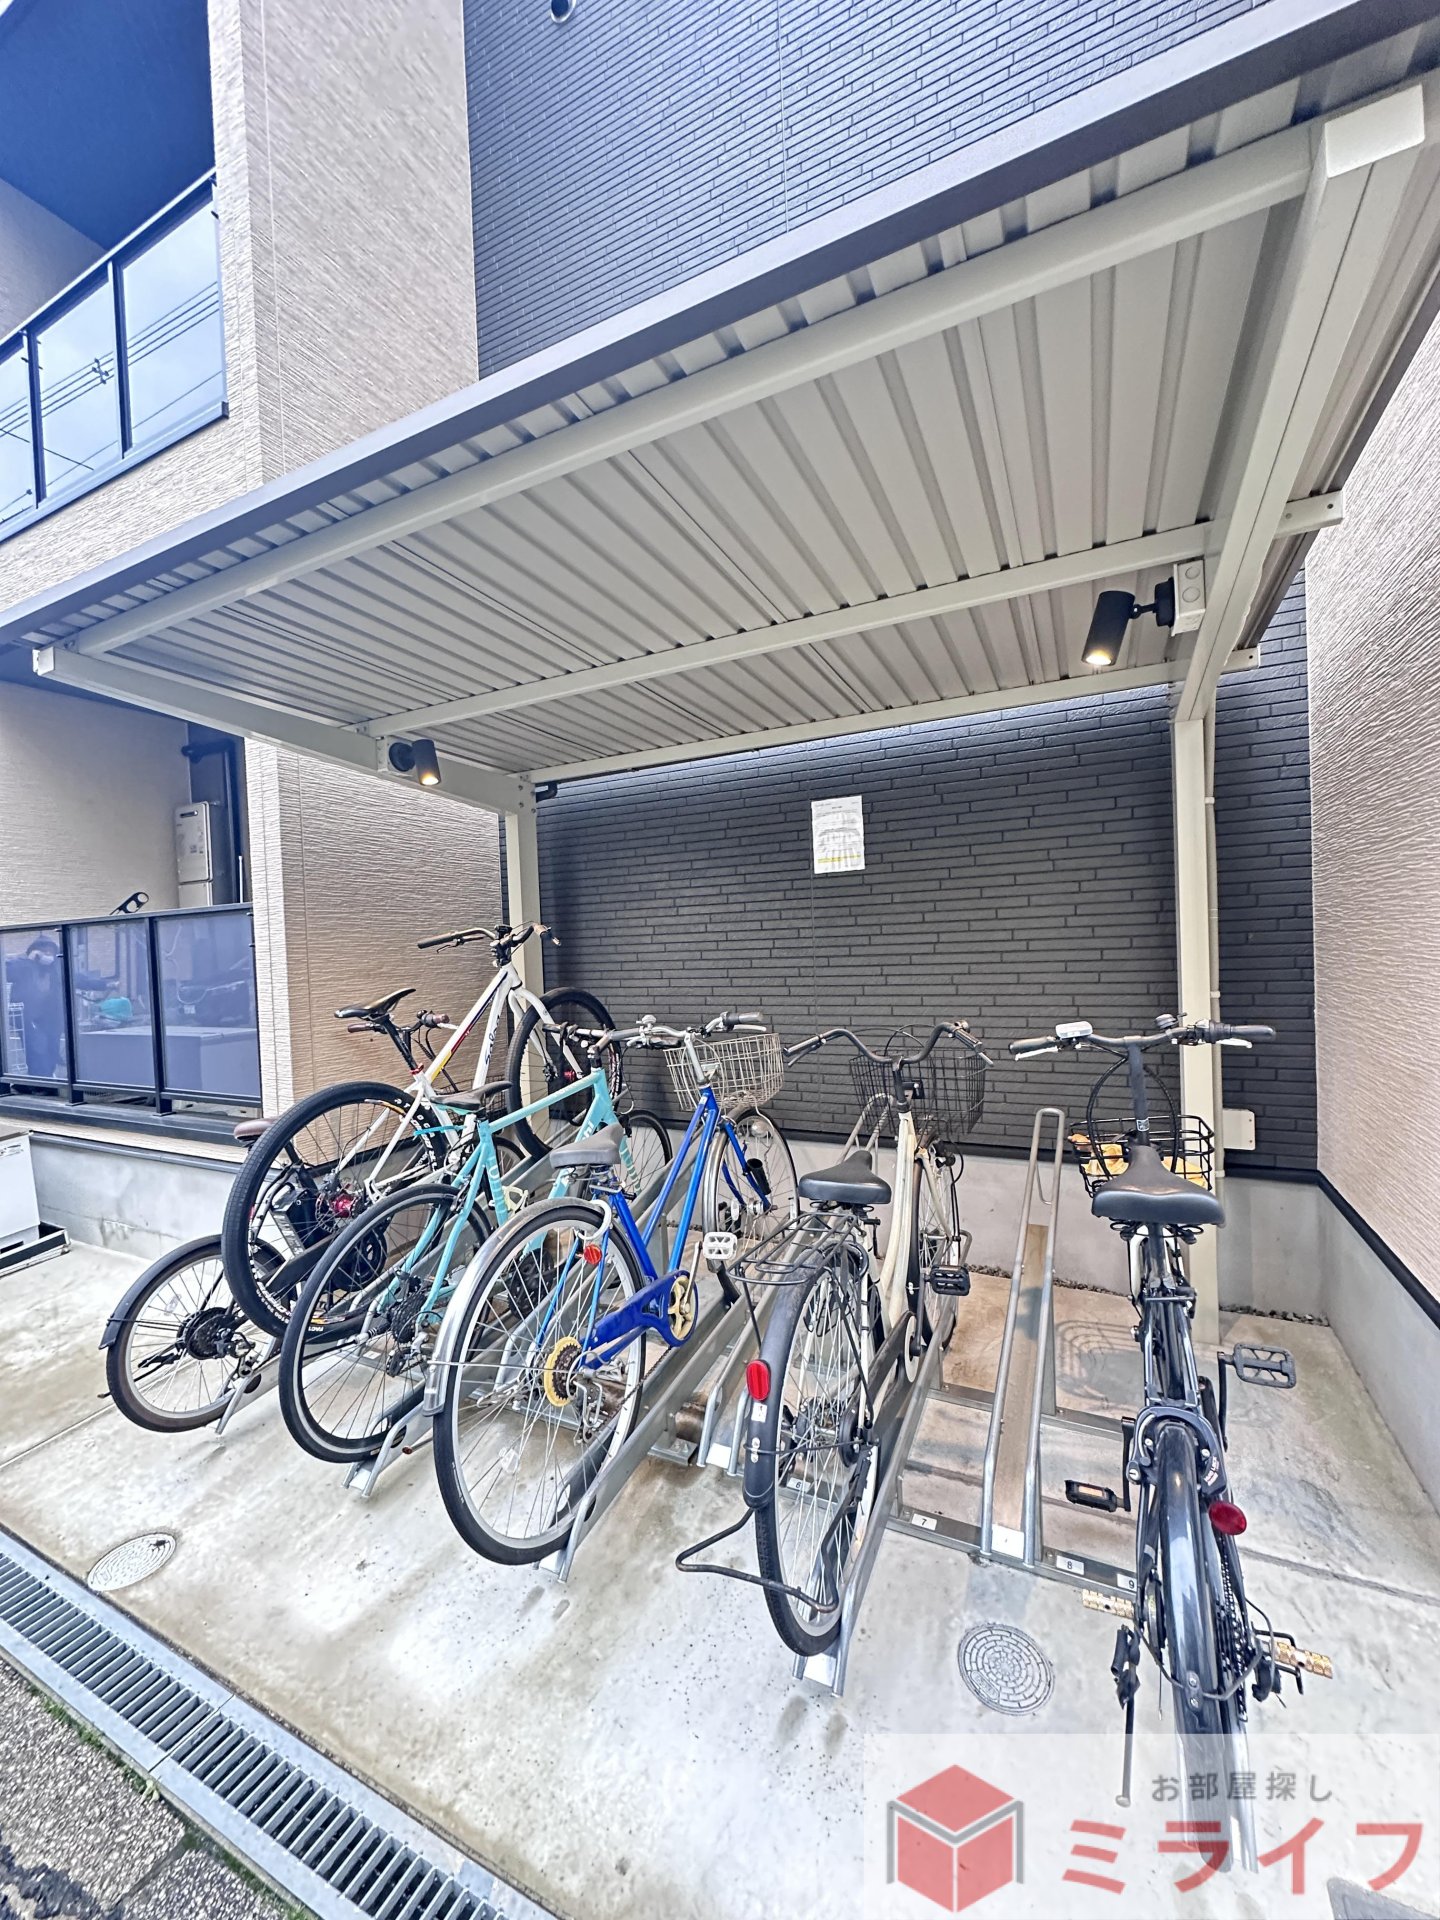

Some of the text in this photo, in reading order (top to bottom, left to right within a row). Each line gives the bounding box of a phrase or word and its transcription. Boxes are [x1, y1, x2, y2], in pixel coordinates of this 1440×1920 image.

[795, 1481, 802, 1489] 6
[921, 1517, 928, 1526] 7
[1066, 1560, 1073, 1570] 8
[1128, 1579, 1135, 1589] 9
